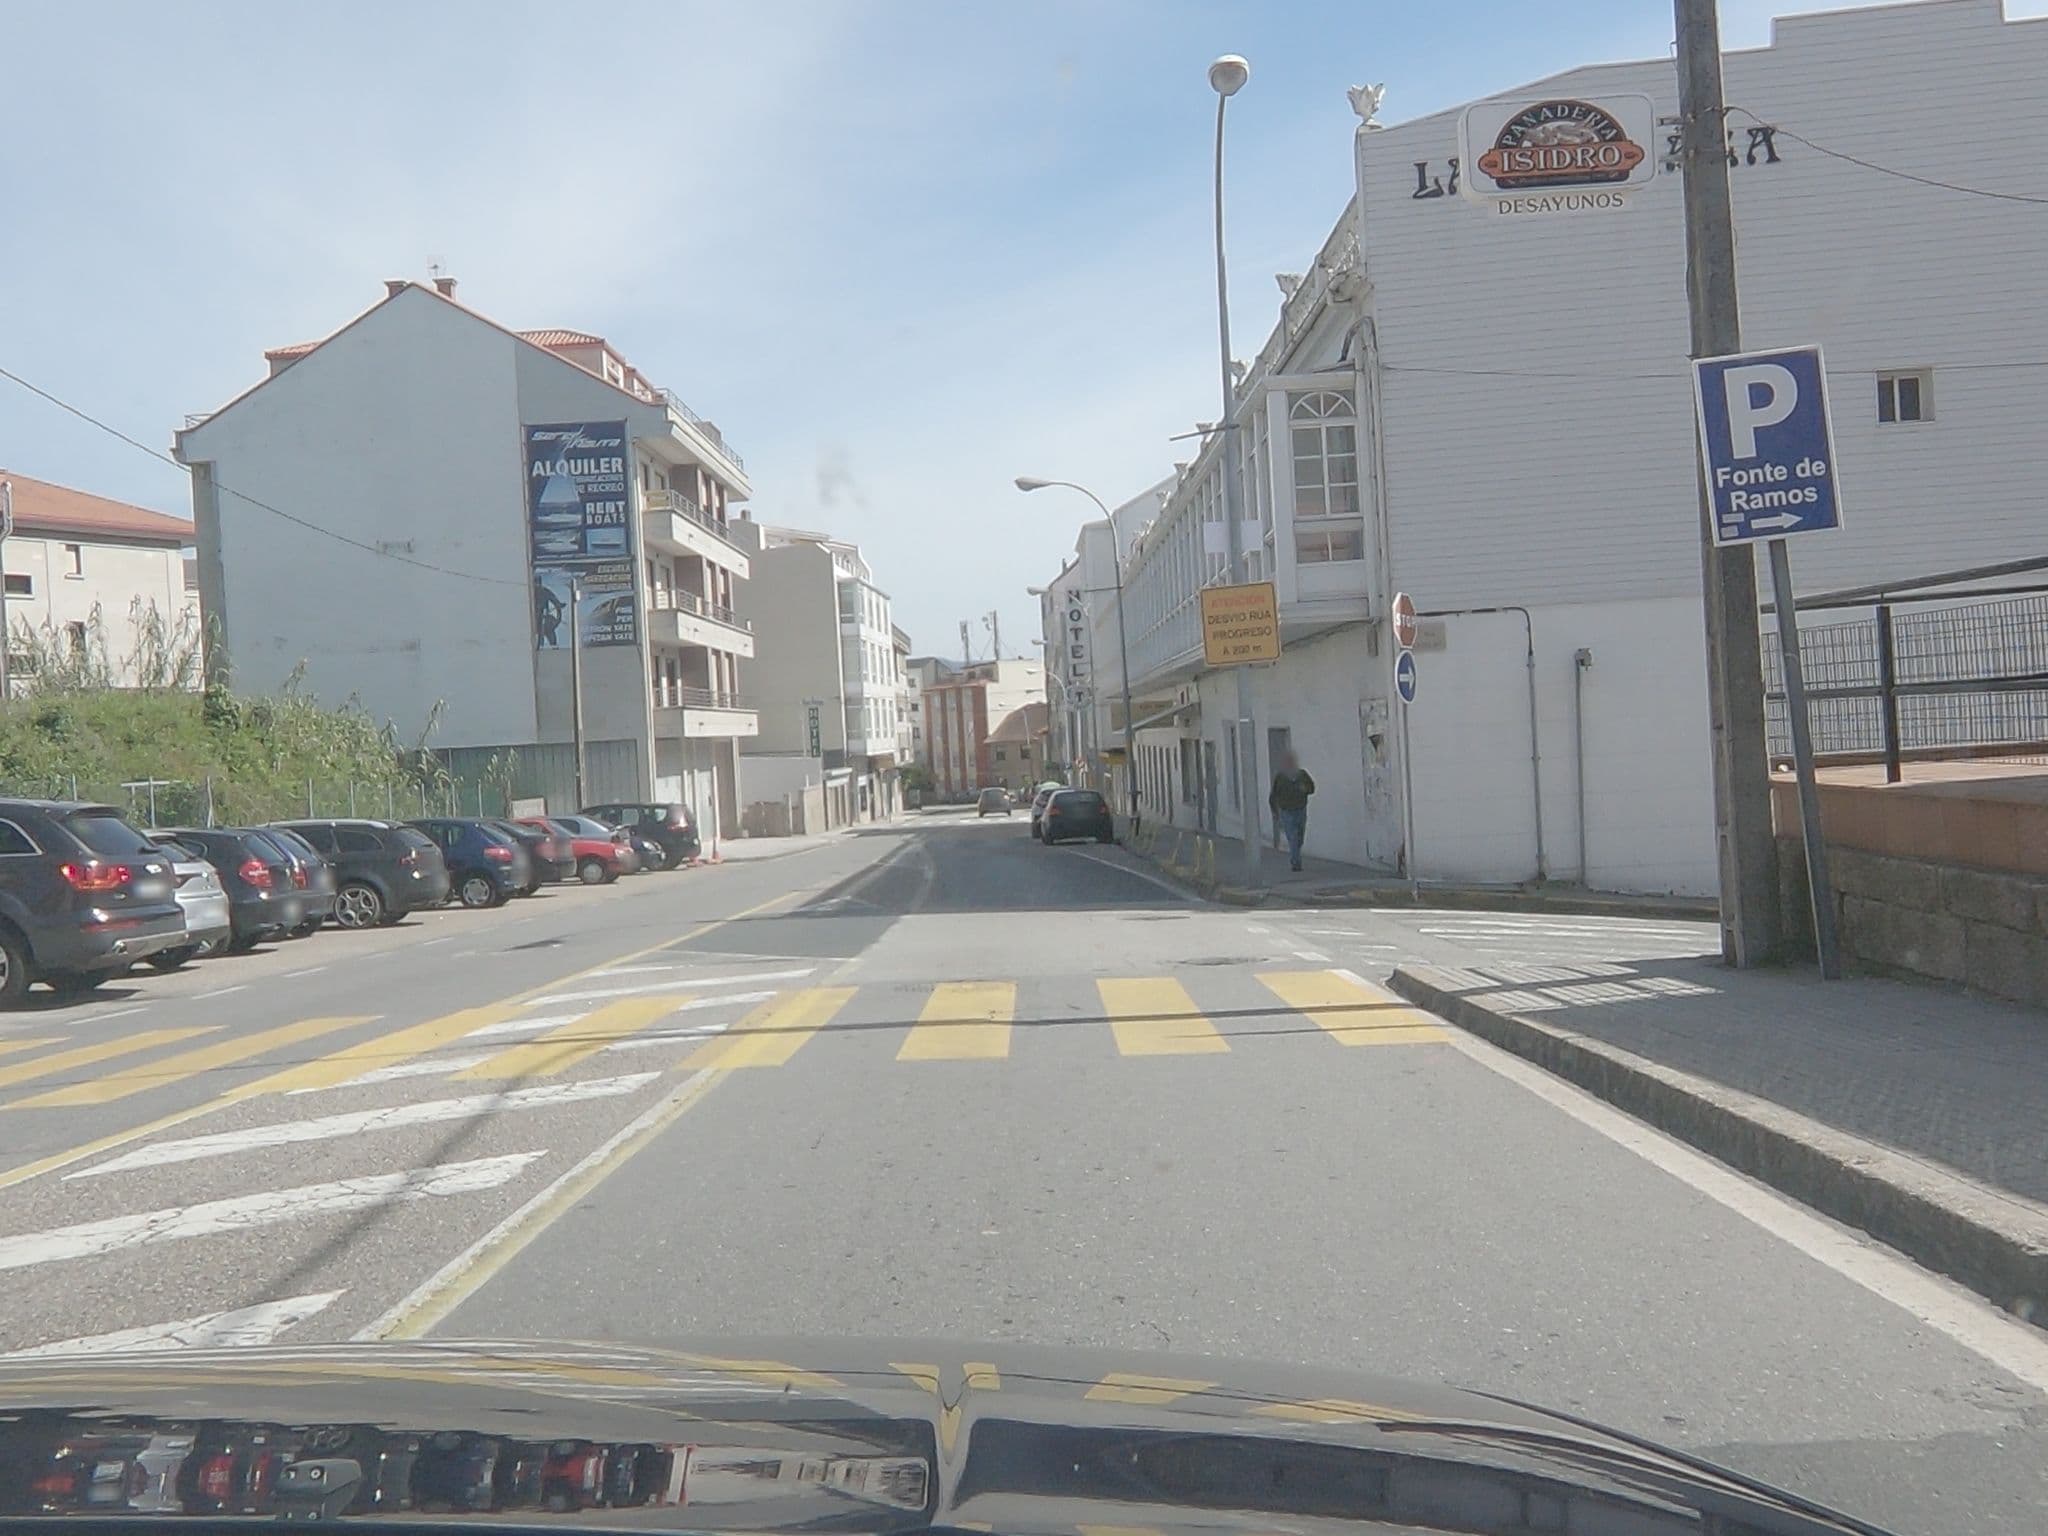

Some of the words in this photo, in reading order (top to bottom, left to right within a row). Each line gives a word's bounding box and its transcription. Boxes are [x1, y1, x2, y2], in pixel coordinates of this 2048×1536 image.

[1502, 145, 1621, 172] ISIDRO
[1499, 192, 1624, 215] DESAYUNOS
[1723, 363, 1798, 459] P
[532, 457, 623, 478] ALQUILER
[1716, 462, 1787, 488] Fonte
[1796, 457, 1826, 478] de
[586, 501, 625, 514] RENT
[1730, 486, 1818, 512] Ramos
[586, 512, 626, 525] BOATS
[1249, 609, 1272, 622] RUA
